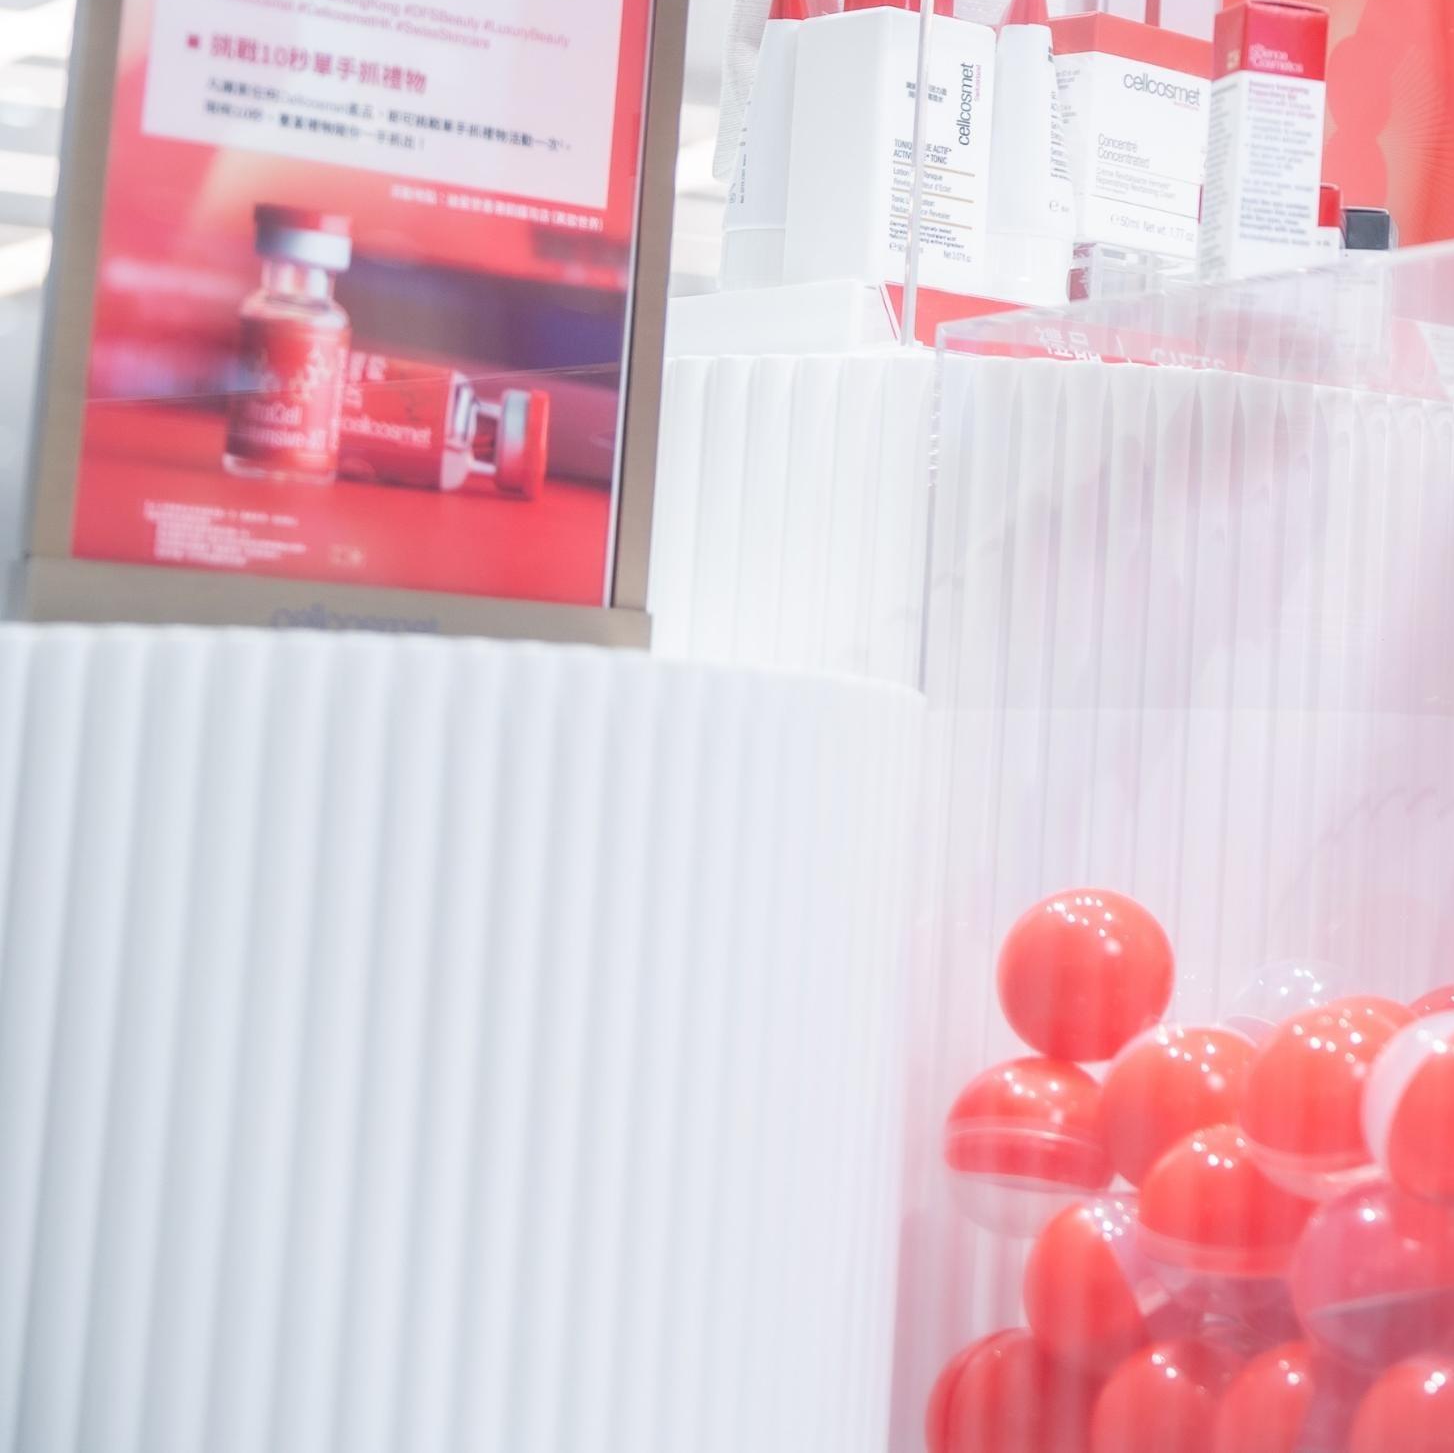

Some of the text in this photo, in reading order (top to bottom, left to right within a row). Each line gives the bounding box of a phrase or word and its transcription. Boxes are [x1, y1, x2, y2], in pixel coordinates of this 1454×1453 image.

[210, 33, 427, 94] 挑戰10秒單手抓禮物
[1124, 73, 1200, 107] cellcosmet
[956, 63, 974, 146] cellcosmet
